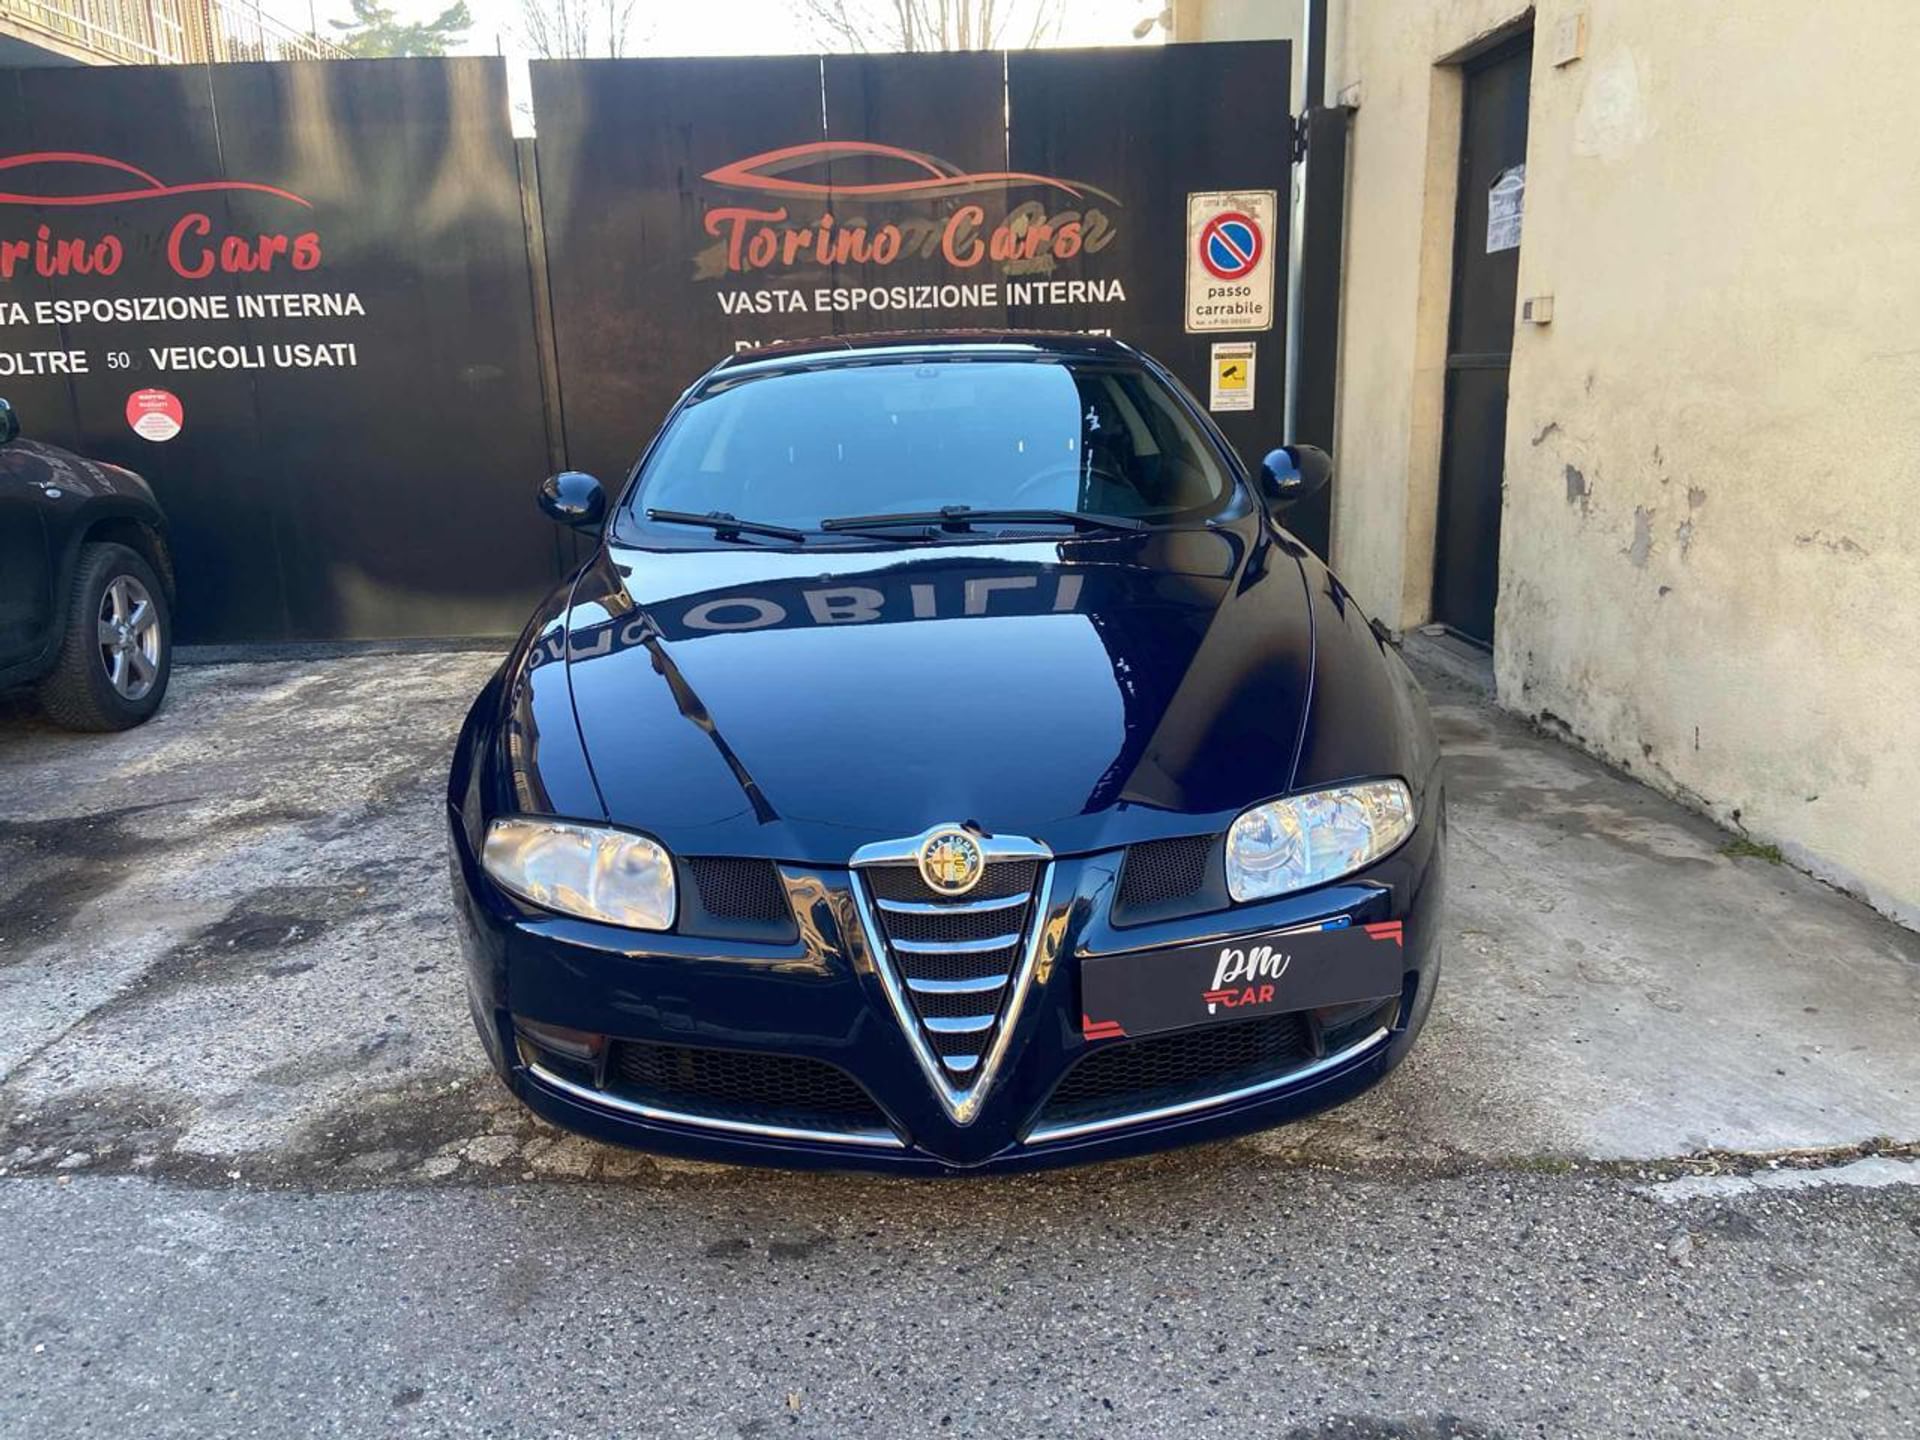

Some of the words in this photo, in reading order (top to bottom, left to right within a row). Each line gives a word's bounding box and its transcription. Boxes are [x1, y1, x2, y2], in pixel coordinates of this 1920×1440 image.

[167, 213, 322, 279] Cars
[704, 207, 901, 271] Torino
[942, 205, 1081, 268] Cars
[35, 296, 229, 324] ESPOSIZIONE
[237, 293, 366, 319] INTERNA
[718, 290, 808, 315] VASTA
[815, 283, 998, 312] ESPOSIZIONE
[1006, 279, 1126, 306] INTERNA
[1196, 301, 1263, 315] carrabile
[1208, 287, 1251, 300] passo
[0, 350, 89, 376] OLTRE
[107, 352, 130, 369] 50
[149, 345, 267, 371] VEICOLI
[274, 343, 358, 368] USATI
